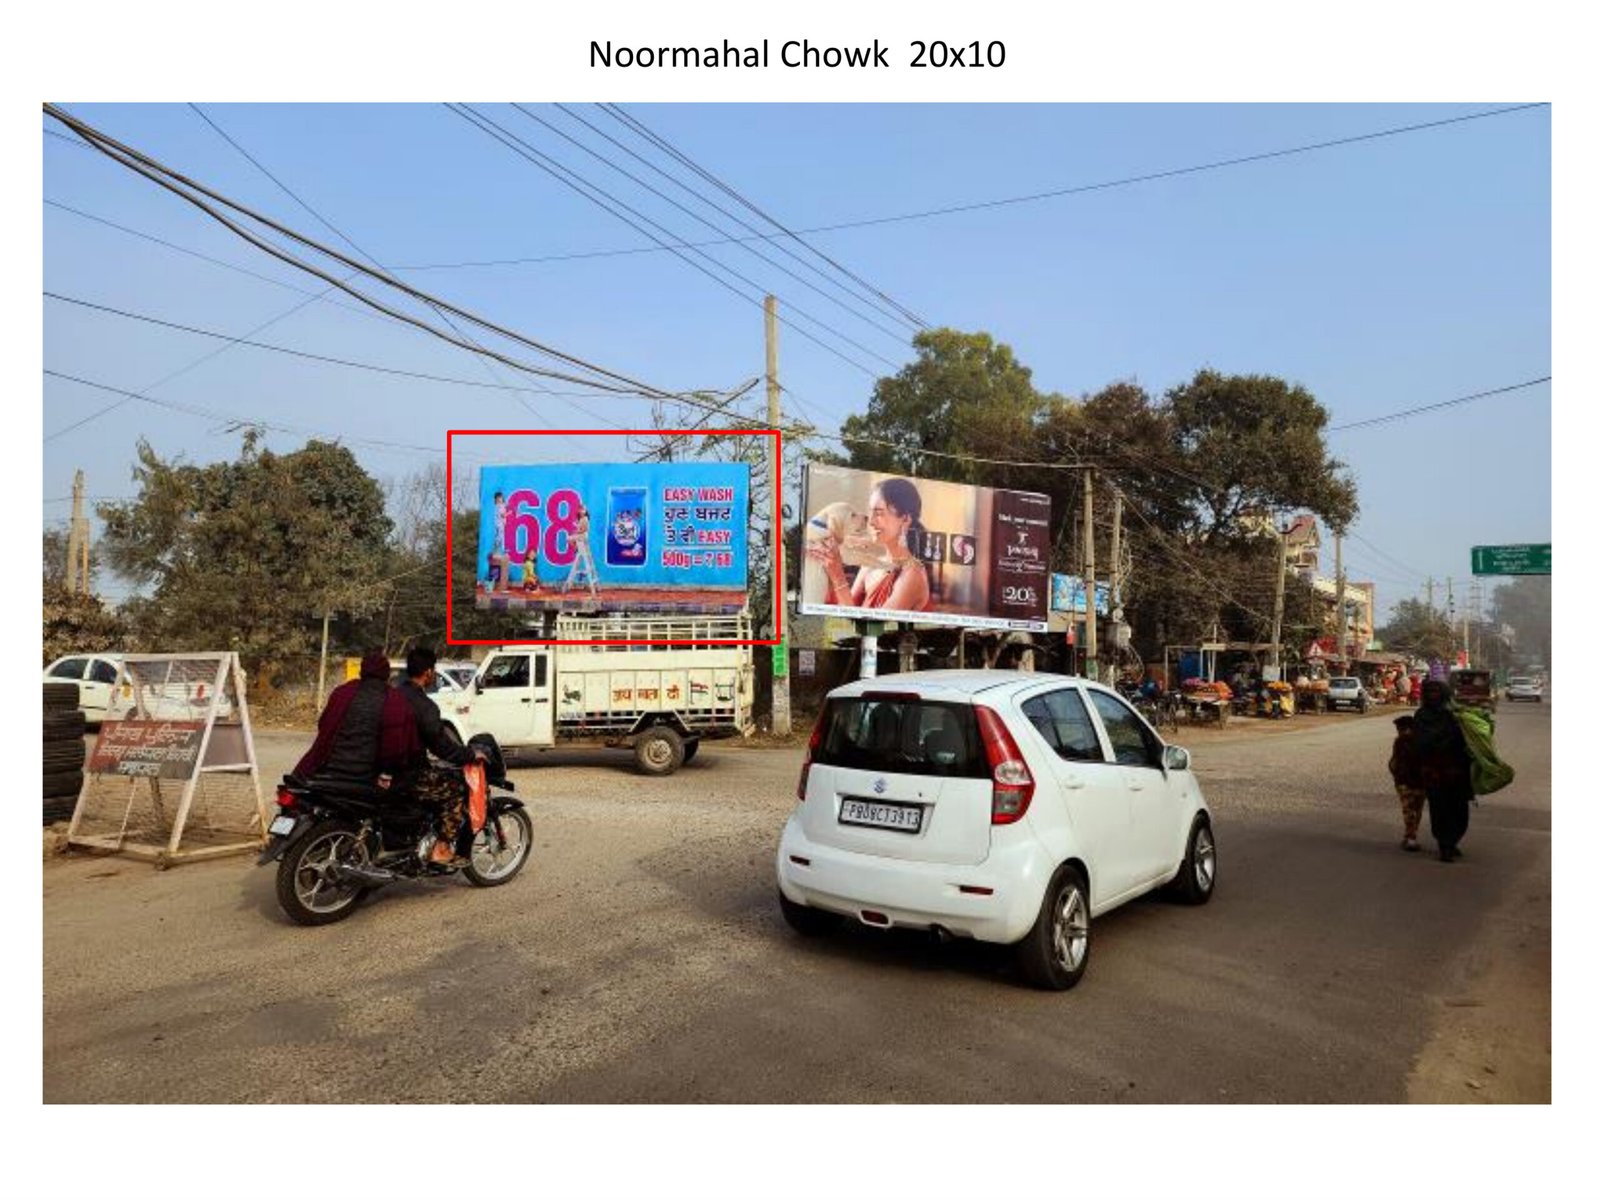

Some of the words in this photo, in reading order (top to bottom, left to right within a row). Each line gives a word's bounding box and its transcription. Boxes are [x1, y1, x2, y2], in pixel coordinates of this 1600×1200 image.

[664, 488, 694, 501] EASY
[698, 488, 733, 501] WASH
[503, 488, 582, 566] 68
[697, 530, 730, 544] EASY
[663, 550, 692, 568] 500g
